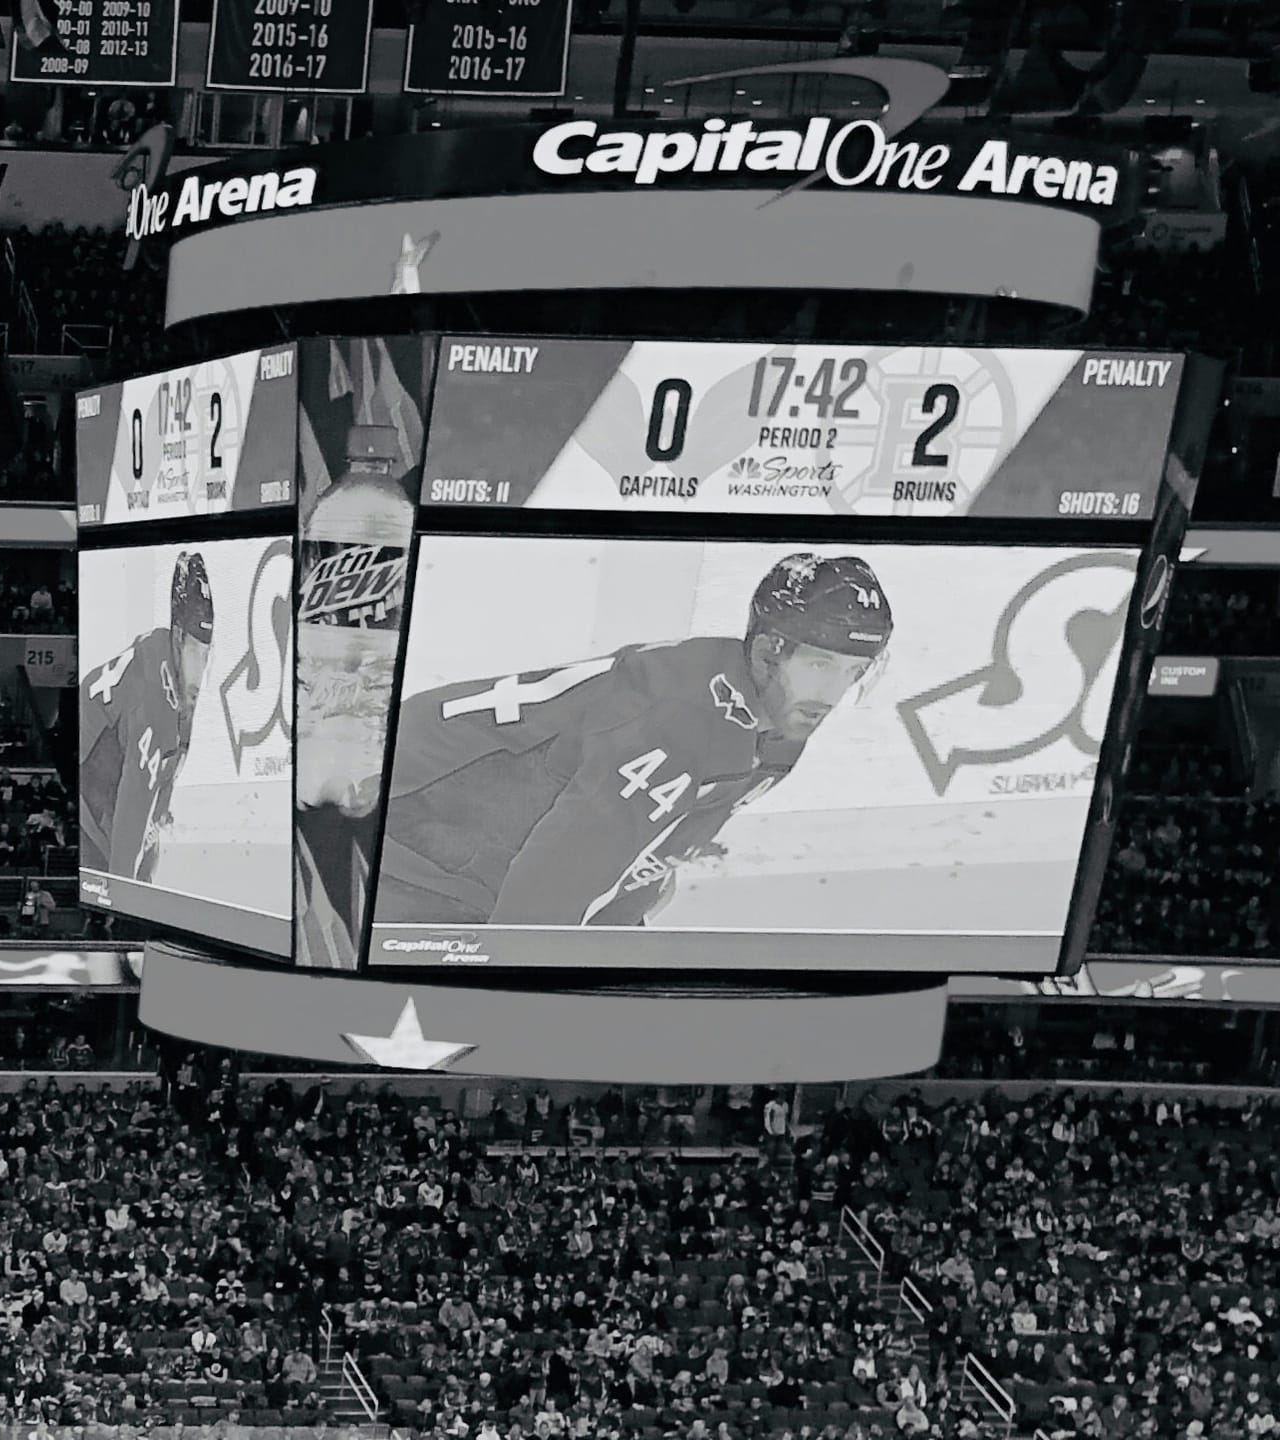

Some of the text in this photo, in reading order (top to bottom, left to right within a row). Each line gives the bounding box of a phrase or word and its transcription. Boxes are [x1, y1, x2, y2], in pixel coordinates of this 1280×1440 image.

[101, 1, 151, 18] 2009-10
[100, 20, 149, 38] 2010-11
[250, 22, 329, 49] 2015-16
[451, 24, 528, 51] 2015-16
[99, 40, 149, 57] 2012-13
[40, 57, 89, 75] 2008-09
[247, 53, 327, 79] 2016-17
[448, 55, 526, 81] 2016-17
[956, 139, 1118, 206] Arena
[171, 164, 318, 226] Arena
[448, 344, 539, 374] PENALTY
[1082, 358, 1173, 388] PENALTY
[747, 356, 868, 419] 17:42
[158, 377, 192, 437] 17:42
[645, 378, 693, 463] 0
[210, 392, 222, 469] 2
[758, 427, 838, 450] PERIOD 2
[911, 383, 961, 468] 2
[132, 408, 143, 480] 0
[761, 456, 842, 483] Sports
[430, 478, 493, 502] SHOTS:
[619, 475, 699, 498] CAPITALS
[727, 484, 832, 498] WASHINGTON
[892, 480, 957, 502] BRUINS
[1058, 491, 1140, 516] SHOTS: 16
[856, 580, 881, 609] 44
[26, 651, 54, 666] 215
[1159, 666, 1207, 677] CUSTOM
[618, 748, 694, 823] 44
